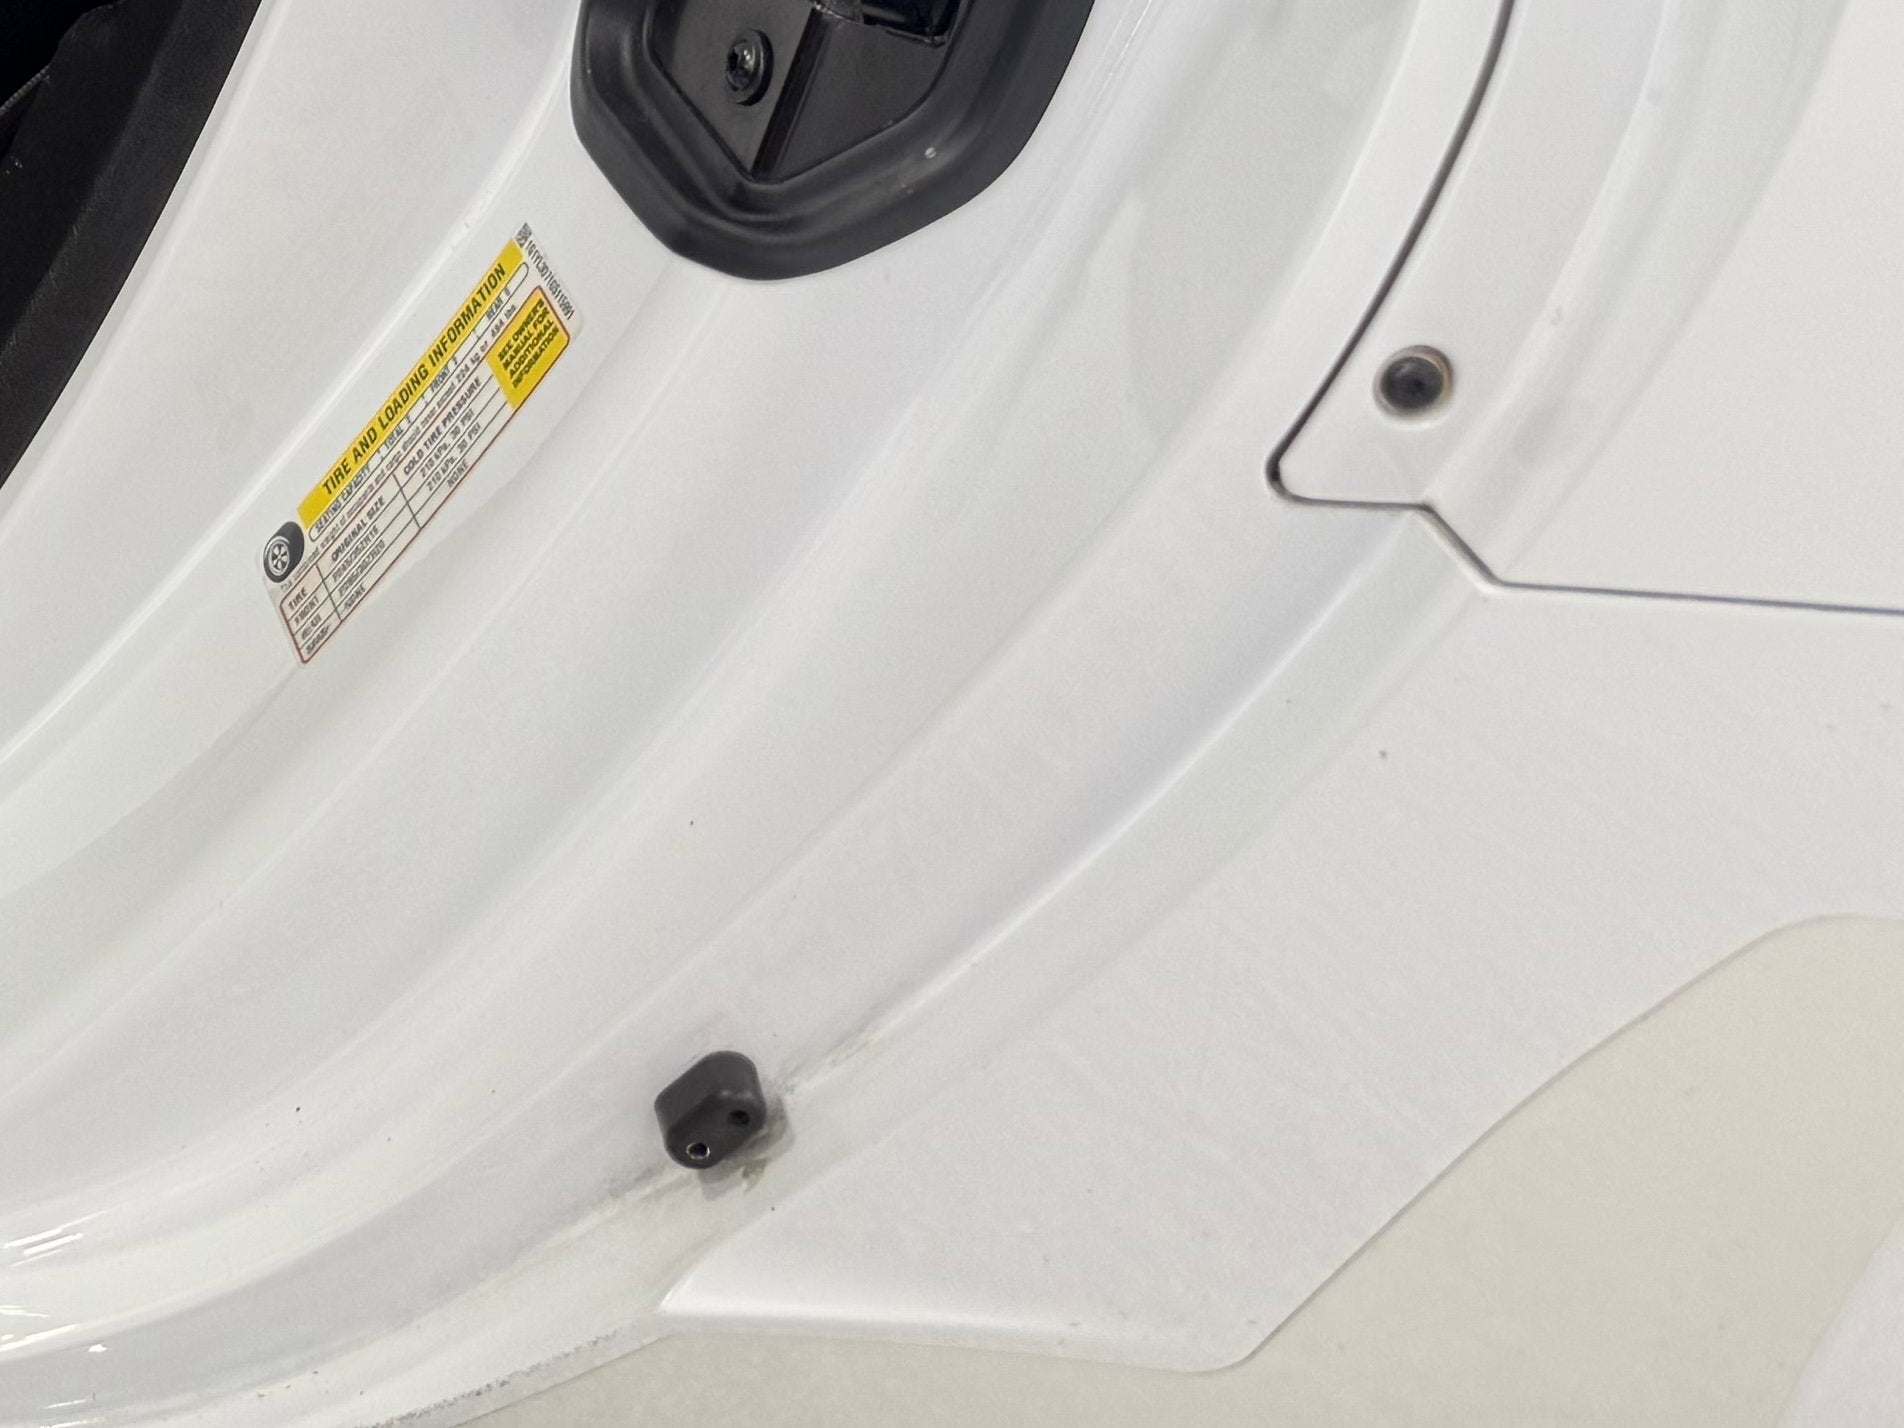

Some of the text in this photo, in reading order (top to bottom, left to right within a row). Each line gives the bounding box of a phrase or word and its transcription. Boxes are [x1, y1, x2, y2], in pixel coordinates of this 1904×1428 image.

[496, 297, 545, 362] SEE OWNER'S
[500, 306, 550, 371] MANUAL FOR
[506, 316, 555, 380] ADDITIONAL
[510, 323, 561, 389] INFORMATION
[322, 457, 352, 497] TIRE
[348, 423, 379, 464] AND
[375, 359, 430, 431] LOADING
[425, 261, 508, 367] INFORMATION
[402, 374, 482, 477] COLD TIRE PRESSURE
[445, 457, 470, 489] NONE
[329, 515, 368, 564] ORIGINAL
[365, 493, 385, 521] SIZE
[287, 584, 308, 614] TIRE
